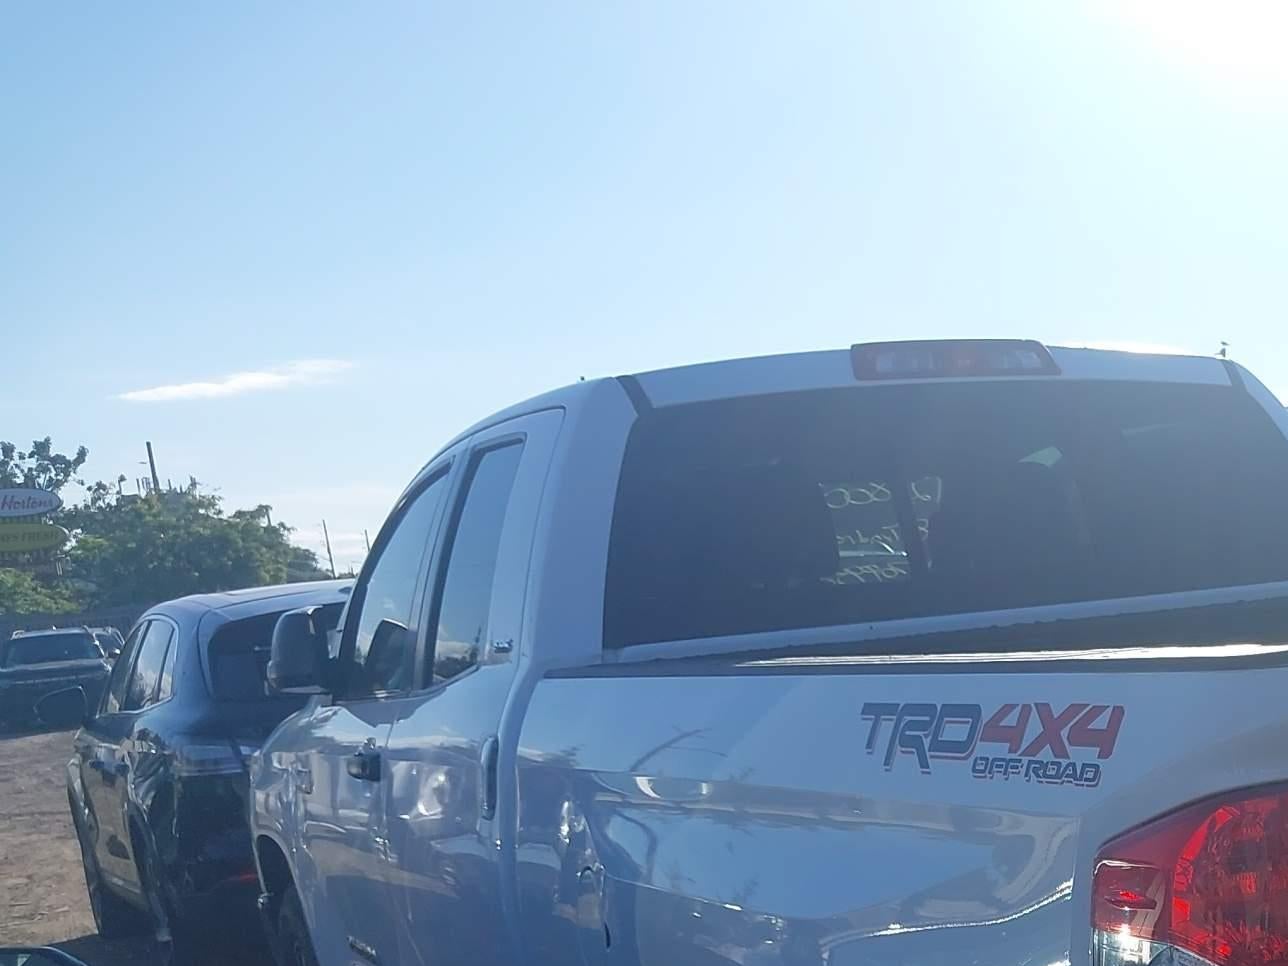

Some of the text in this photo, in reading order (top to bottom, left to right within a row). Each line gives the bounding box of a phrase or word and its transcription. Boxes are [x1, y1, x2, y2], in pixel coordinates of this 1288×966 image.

[860, 702, 982, 775] TRD
[972, 756, 1101, 788] OFF ROAD
